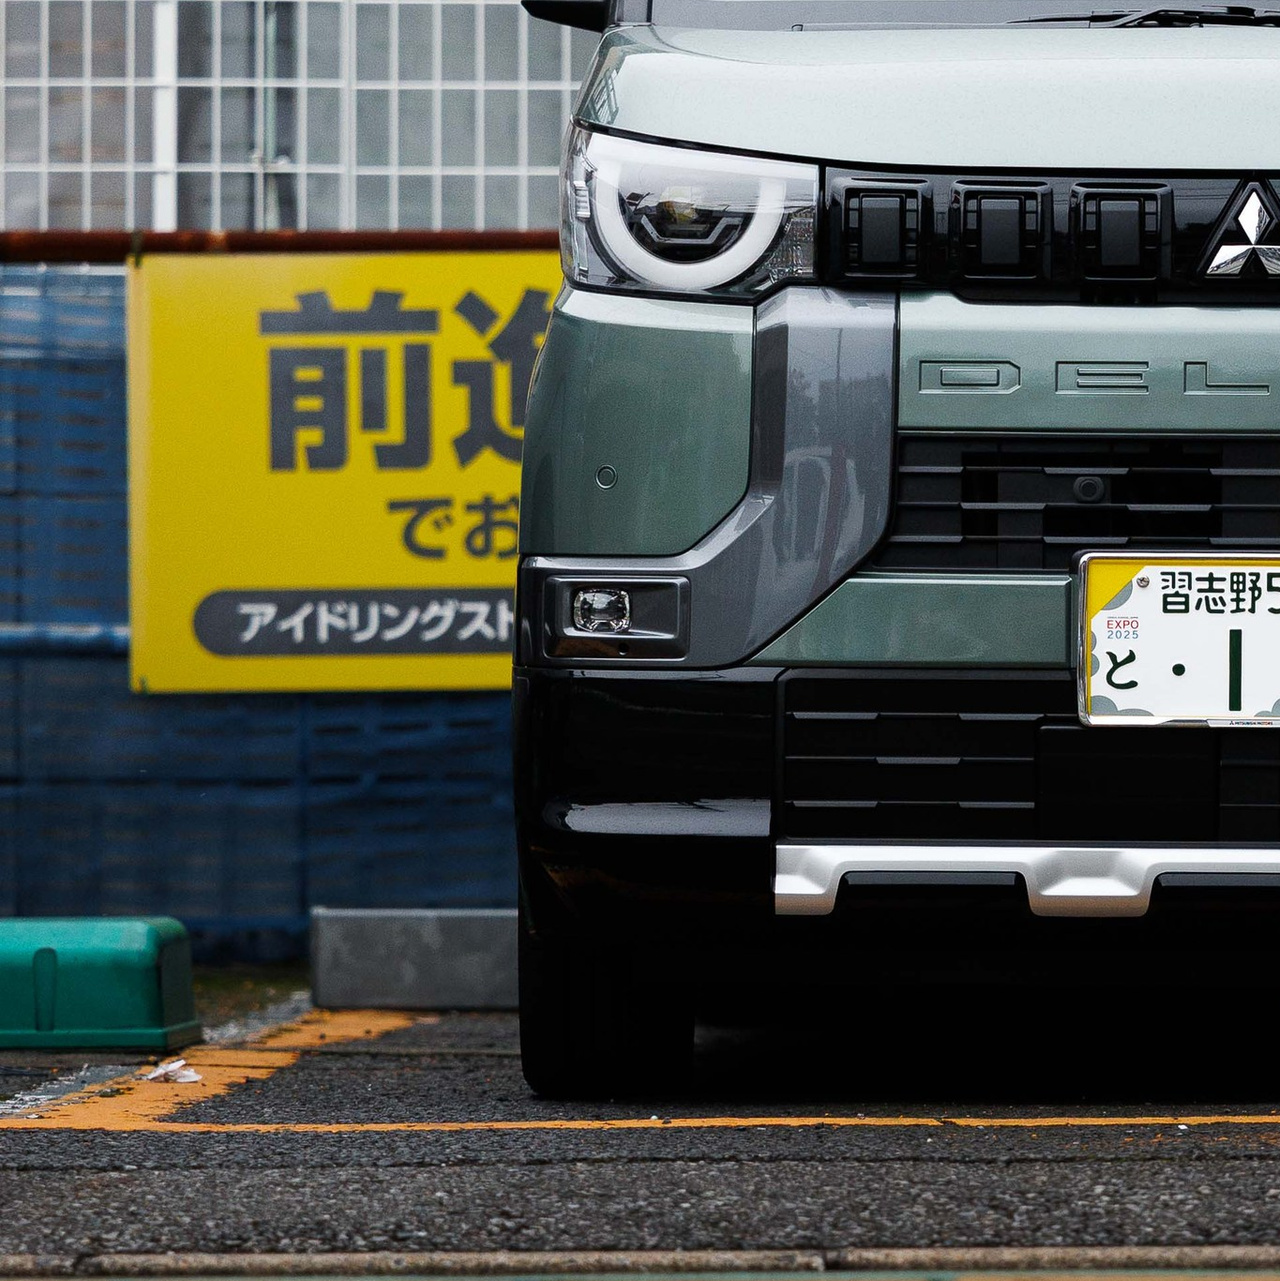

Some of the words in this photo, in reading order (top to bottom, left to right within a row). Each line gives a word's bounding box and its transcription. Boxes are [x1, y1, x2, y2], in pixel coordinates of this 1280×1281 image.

[1106, 619, 1139, 630] EXPO
[1107, 630, 1139, 639] 2025
[1106, 649, 1138, 690] と
